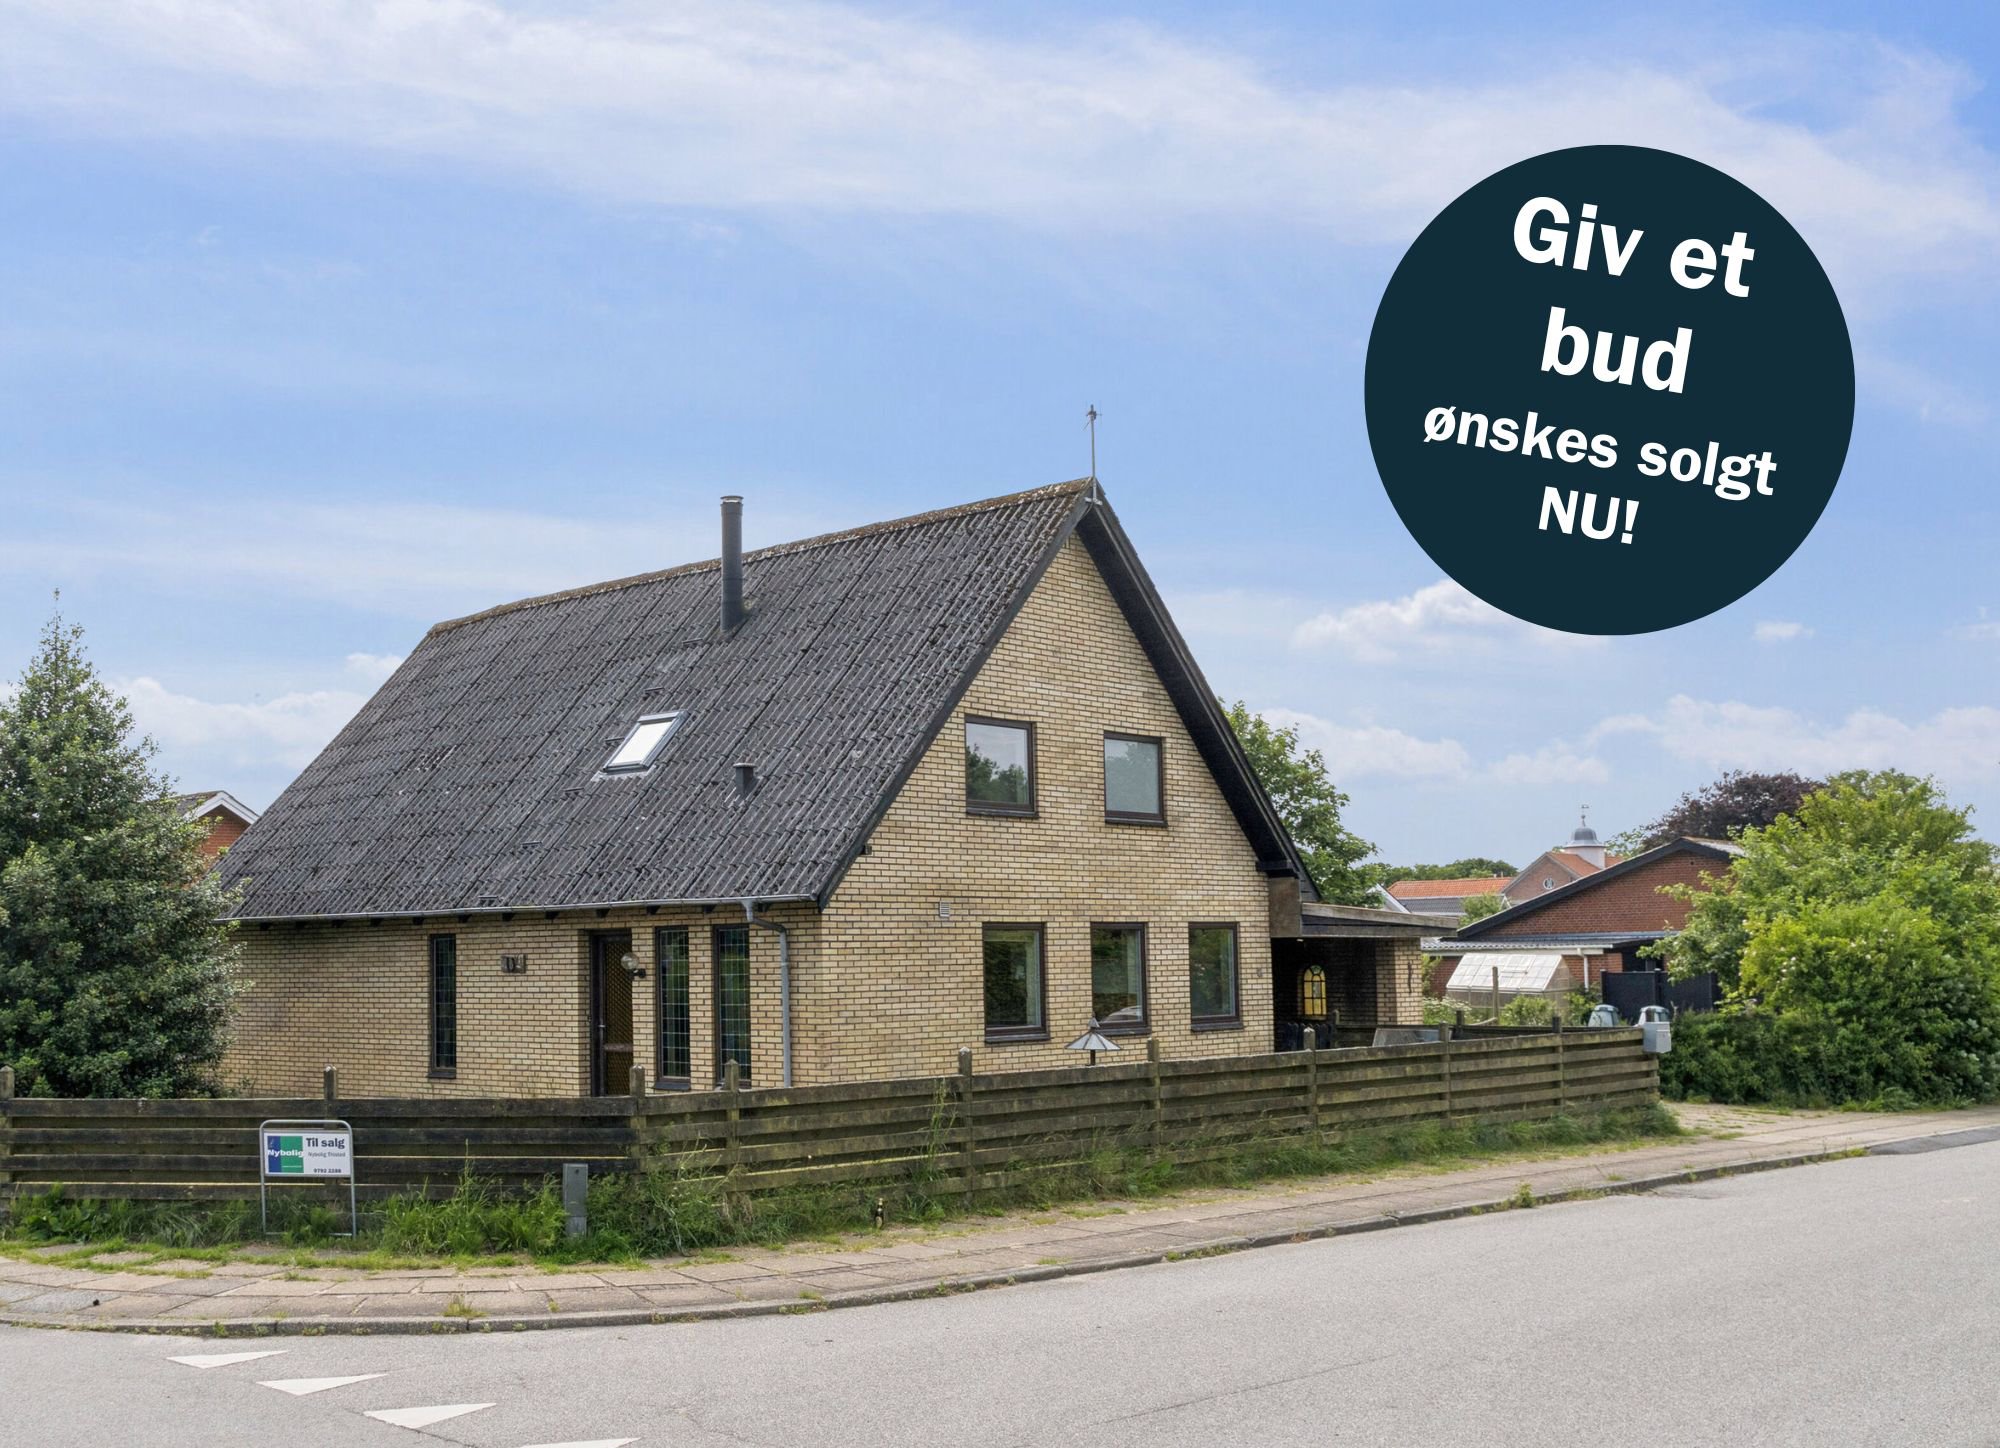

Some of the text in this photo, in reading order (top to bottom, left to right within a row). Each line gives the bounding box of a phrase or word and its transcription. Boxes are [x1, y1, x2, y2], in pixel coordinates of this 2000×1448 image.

[306, 1137, 345, 1149] Til salg
[266, 1149, 304, 1158] Nybolig
